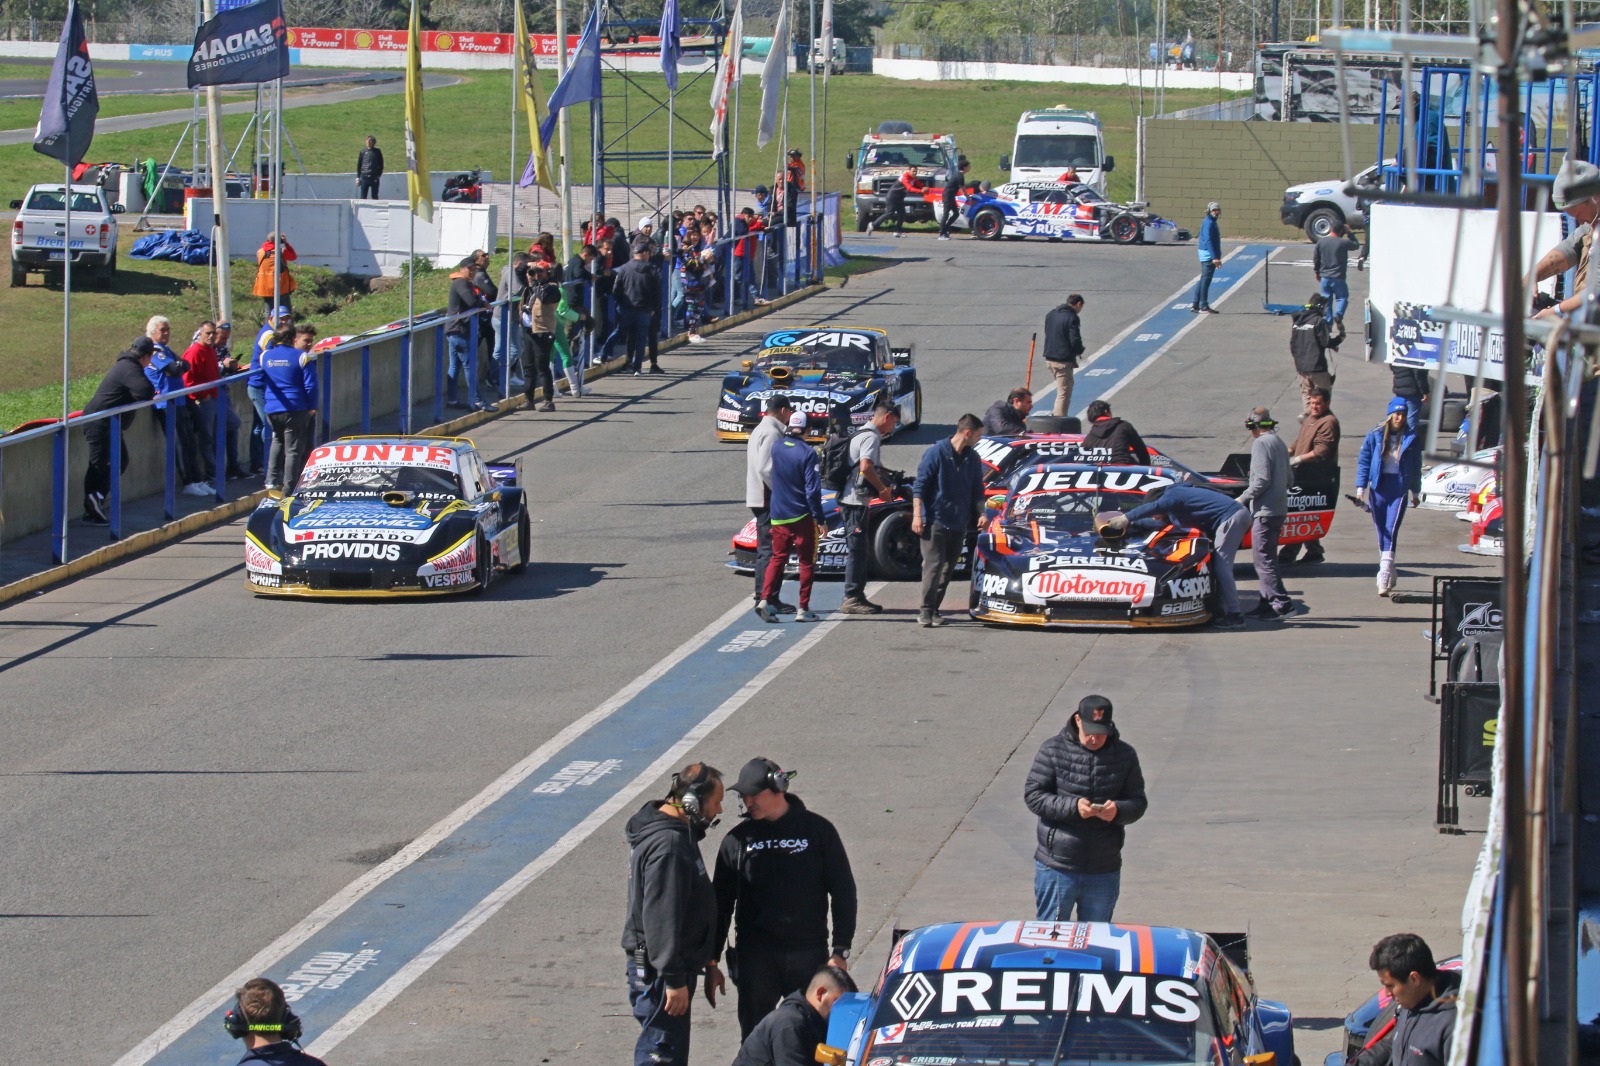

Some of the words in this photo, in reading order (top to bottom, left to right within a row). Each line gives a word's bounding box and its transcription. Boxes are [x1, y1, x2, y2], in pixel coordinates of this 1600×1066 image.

[301, 38, 340, 47] V-Power
[458, 42, 498, 52] V-Power
[1019, 203, 1079, 215] AMA
[1036, 222, 1062, 235] RUS
[305, 445, 453, 469] PUNTE
[293, 519, 427, 528] FIERROMEC
[317, 533, 416, 542] HURTADO
[301, 542, 402, 562] PROVIDUS
[1029, 555, 1149, 573] PEREIRA
[1038, 572, 1147, 605] Motorarg
[941, 971, 1201, 1023] REIMS
[248, 1023, 282, 1032] DAVICOM
[956, 1020, 975, 1028] TCM
[910, 1056, 958, 1064] CRISTEM
